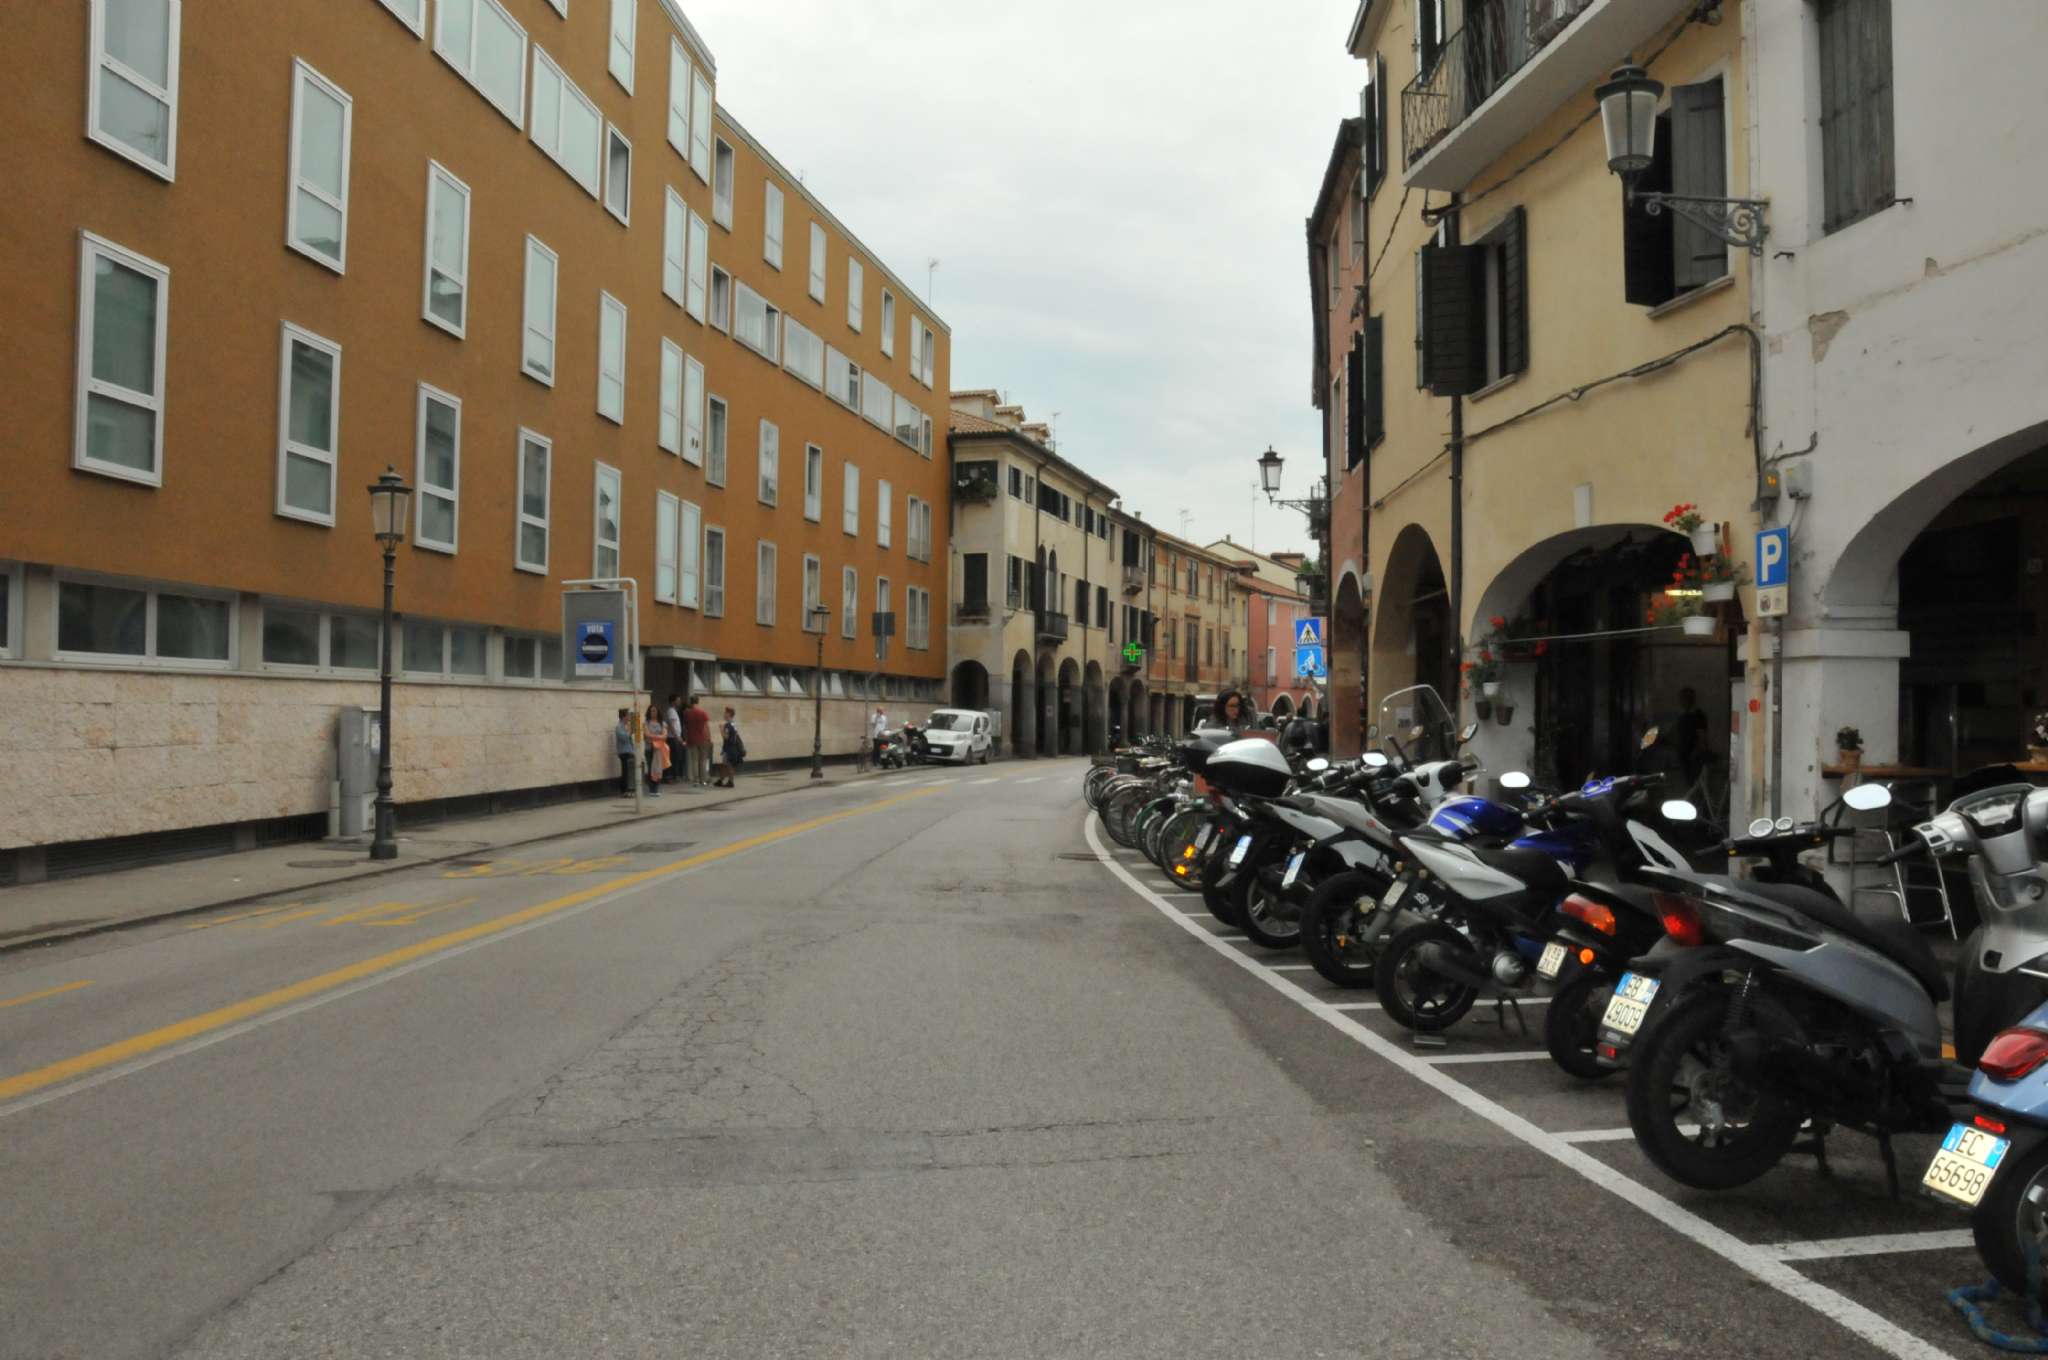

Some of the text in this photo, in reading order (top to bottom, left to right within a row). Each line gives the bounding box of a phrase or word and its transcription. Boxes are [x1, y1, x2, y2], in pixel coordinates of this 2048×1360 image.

[1761, 534, 1783, 582] P
[1955, 1129, 1985, 1157] EC
[1928, 1155, 1986, 1197] 65698
